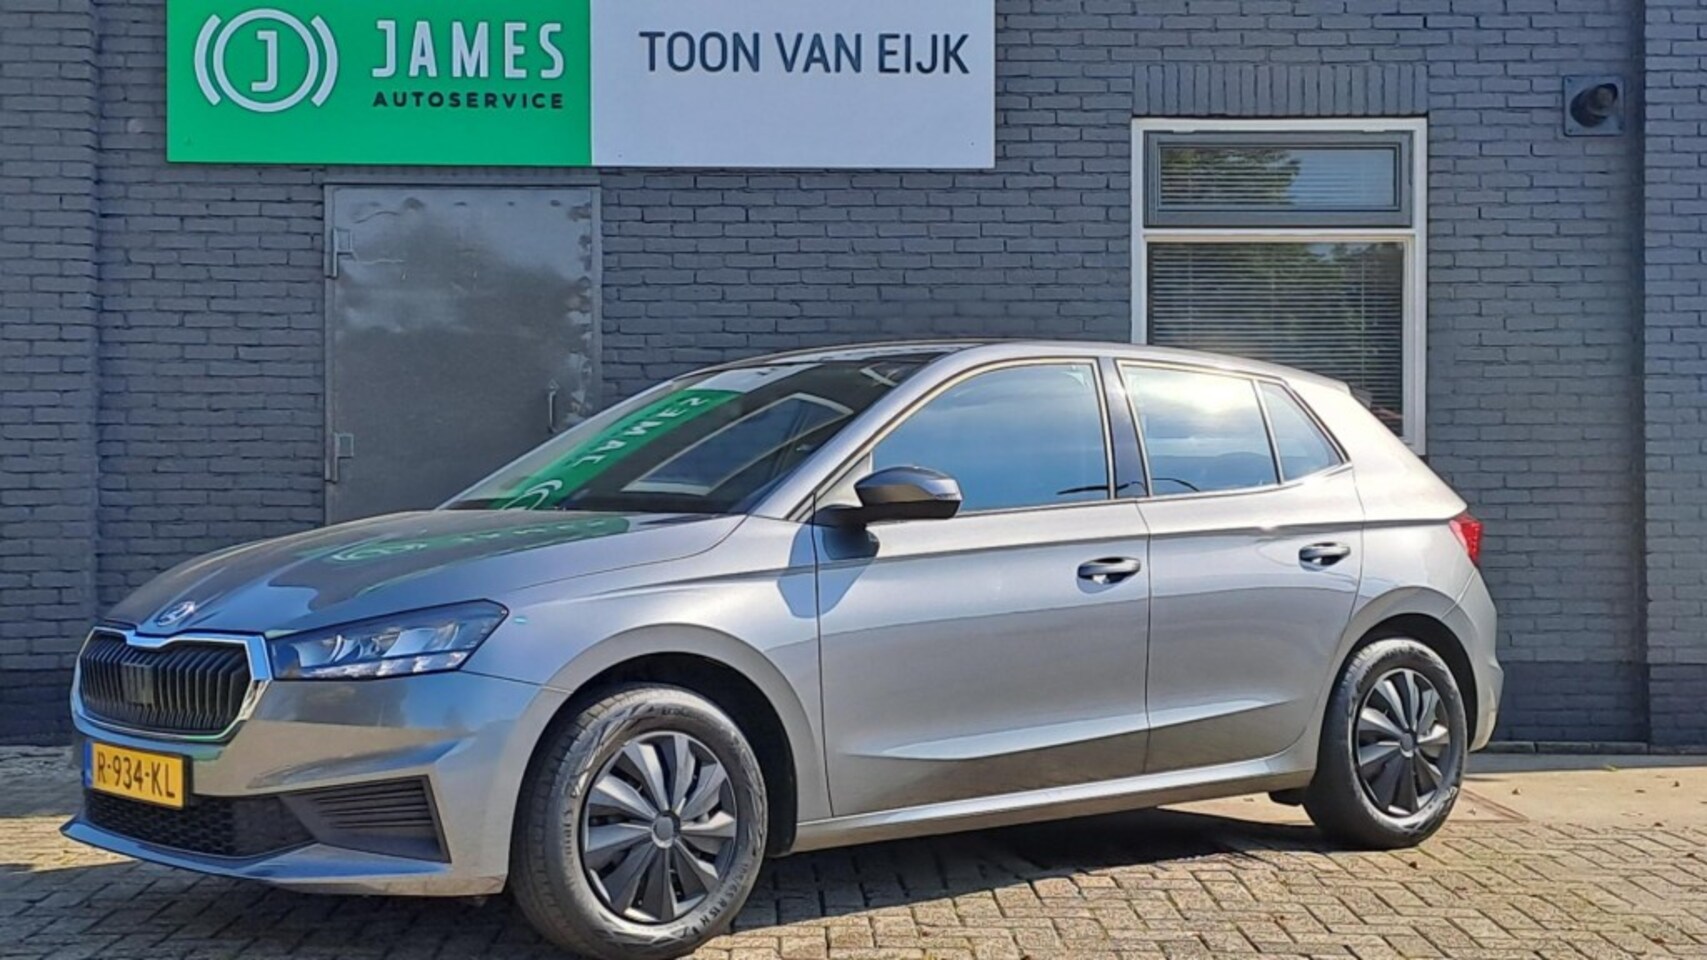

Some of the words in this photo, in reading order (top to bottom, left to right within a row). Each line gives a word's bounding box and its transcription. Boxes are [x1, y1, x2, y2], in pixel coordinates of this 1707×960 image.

[250, 29, 278, 92] J
[371, 19, 565, 79] JAMES
[639, 31, 760, 73] TOON
[775, 32, 862, 73] VAN
[878, 33, 970, 74] EIJK
[372, 91, 564, 109] AUTOSERVICE
[97, 752, 175, 798] R-934-KL
